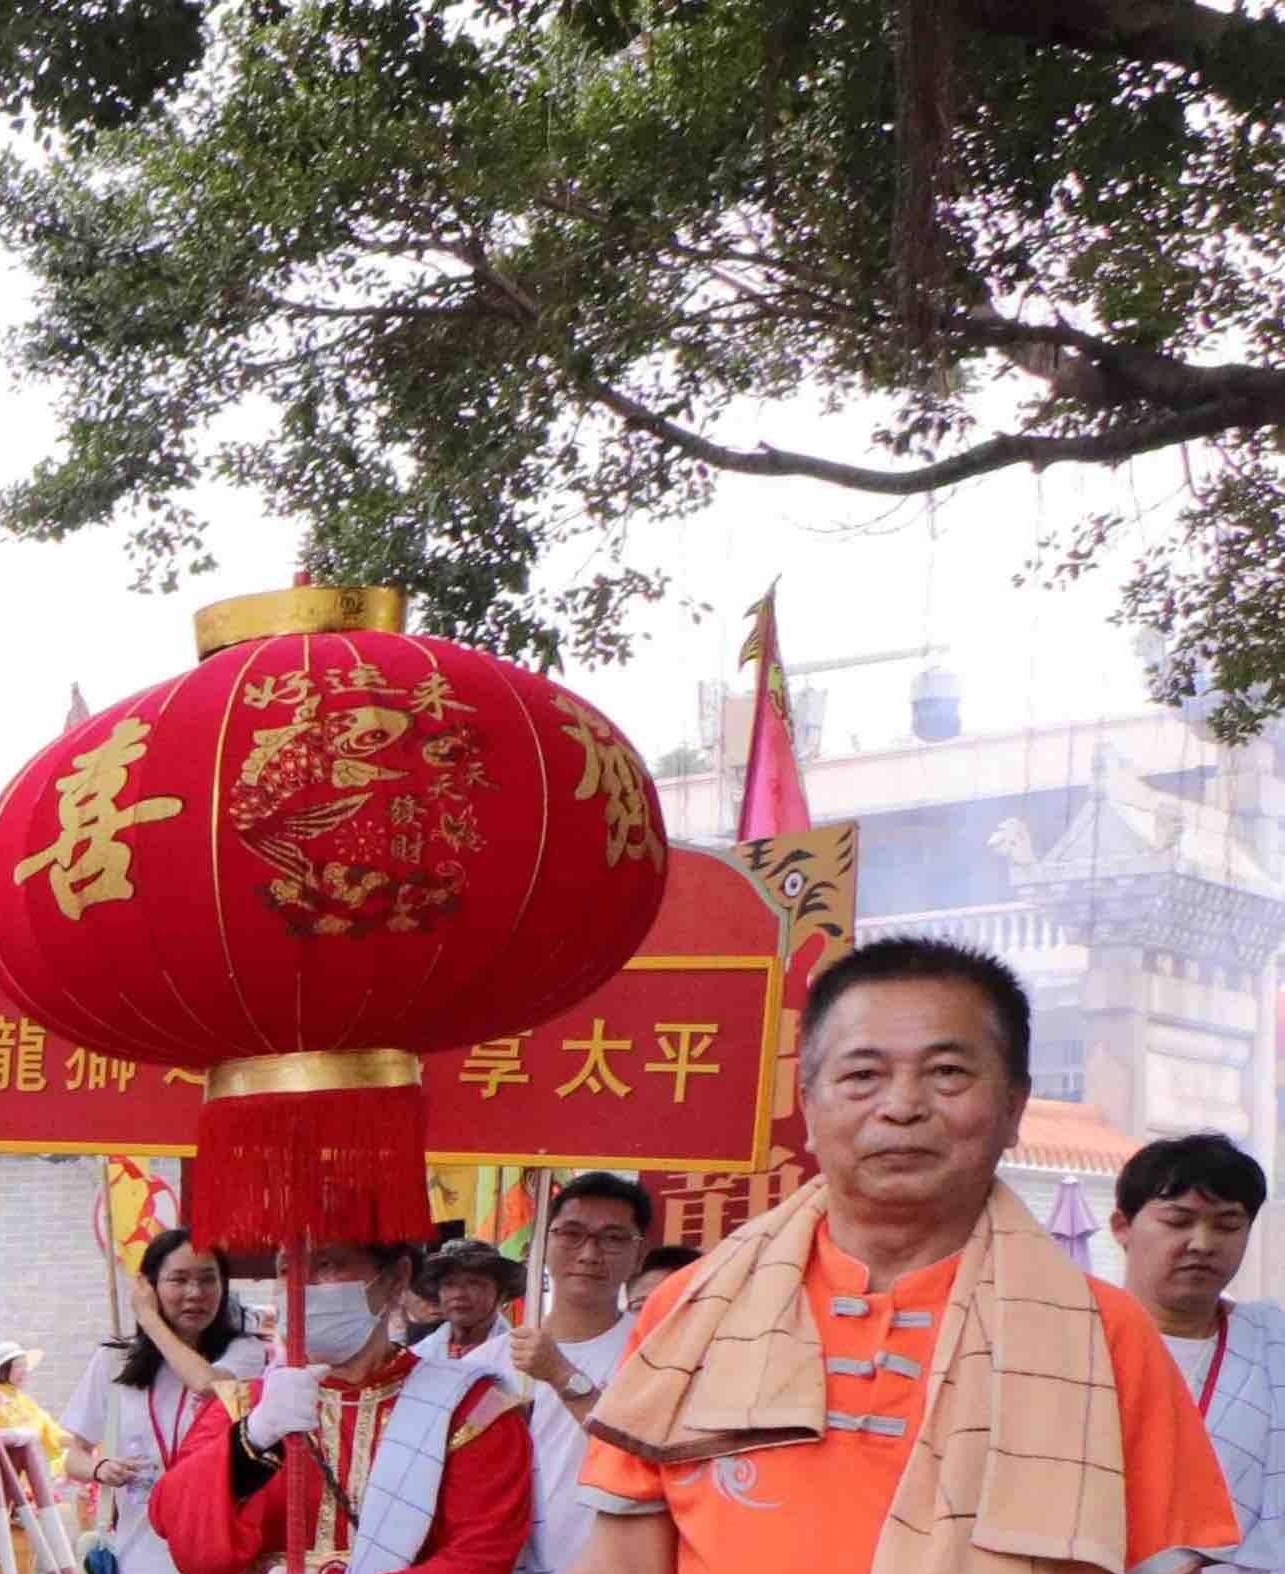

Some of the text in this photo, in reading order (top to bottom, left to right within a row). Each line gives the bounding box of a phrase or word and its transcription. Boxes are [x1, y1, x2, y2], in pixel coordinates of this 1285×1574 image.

[13, 715, 183, 921] 喜
[458, 1018, 721, 1103] 享太平
